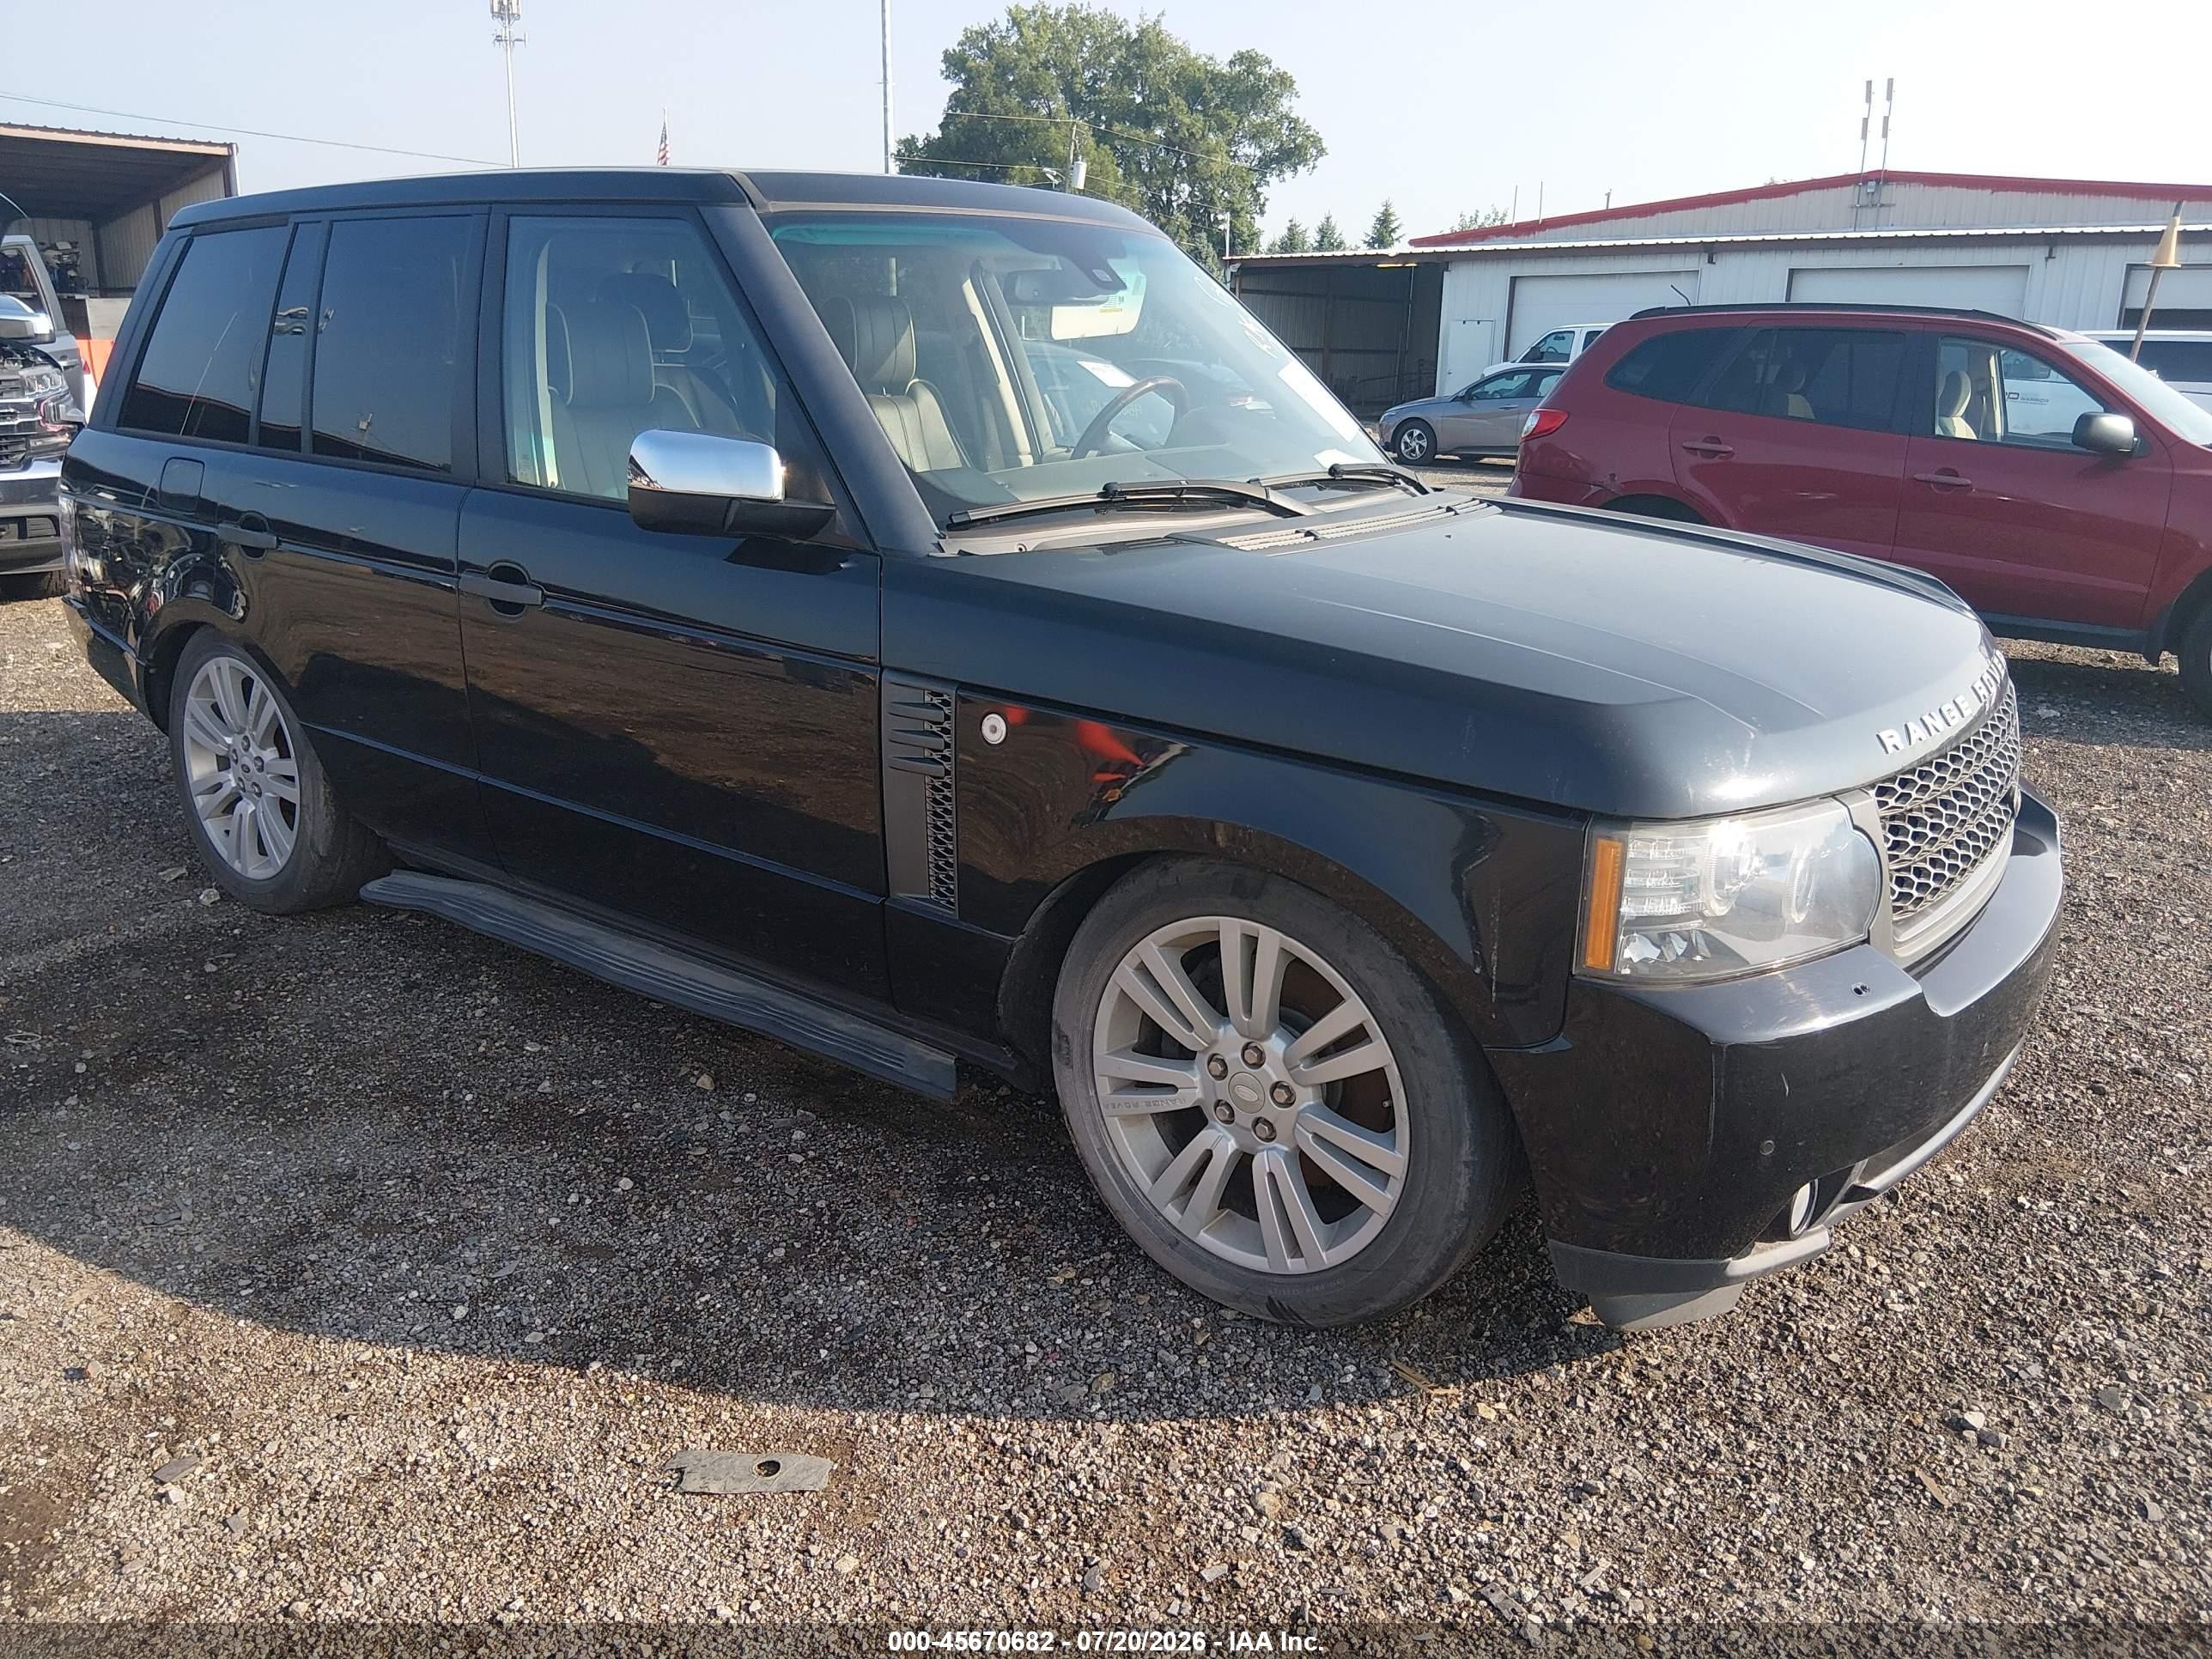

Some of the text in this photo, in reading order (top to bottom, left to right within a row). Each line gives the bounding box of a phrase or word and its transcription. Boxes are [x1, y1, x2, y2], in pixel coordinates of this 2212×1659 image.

[1875, 649, 2008, 755] RANGE ROVER
[1144, 1097, 1187, 1108] RANGE
